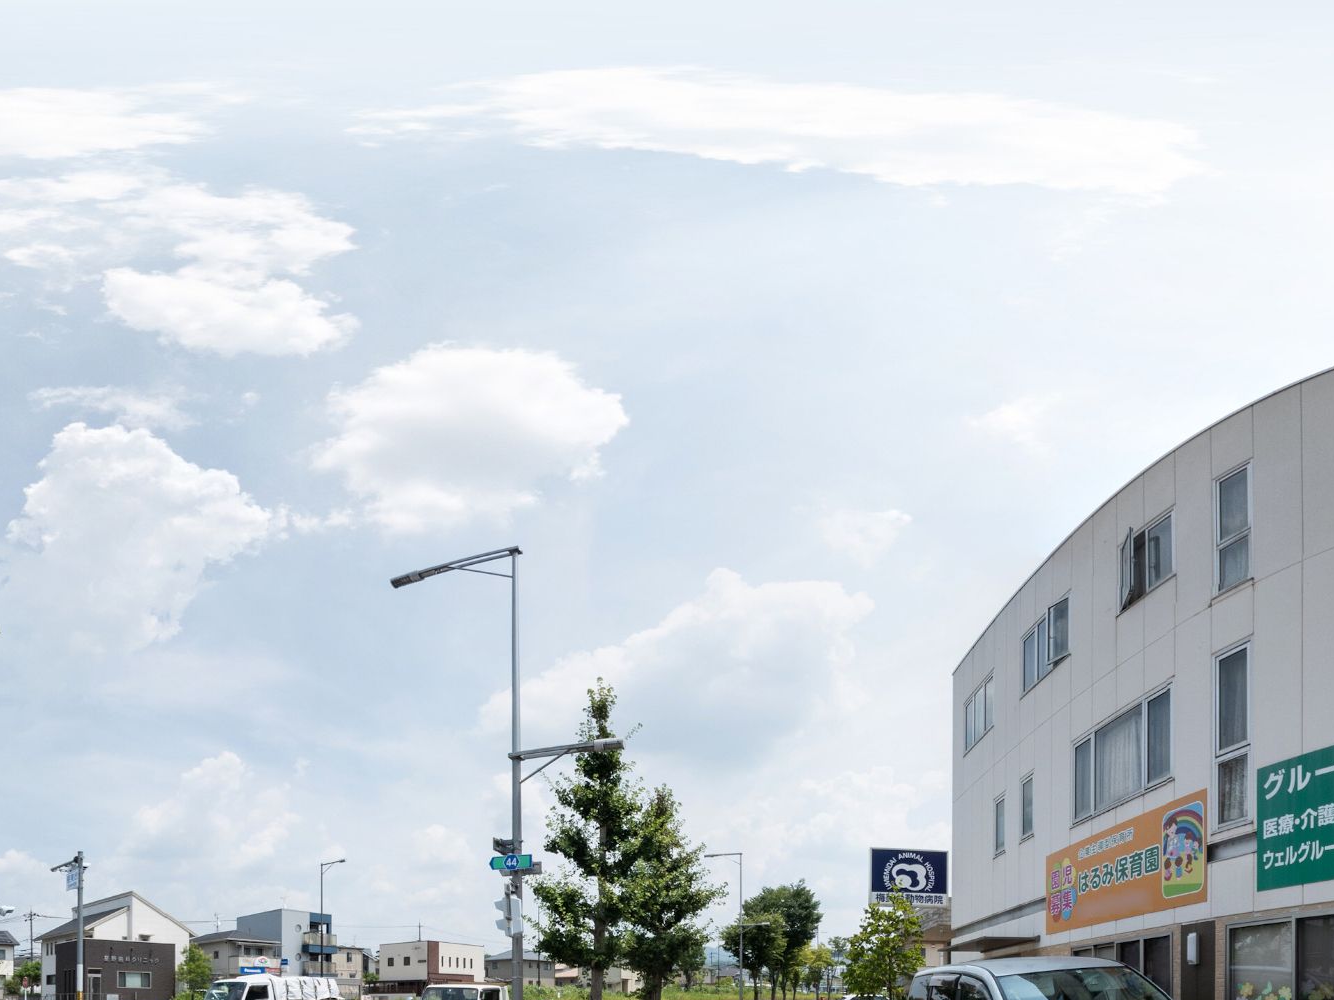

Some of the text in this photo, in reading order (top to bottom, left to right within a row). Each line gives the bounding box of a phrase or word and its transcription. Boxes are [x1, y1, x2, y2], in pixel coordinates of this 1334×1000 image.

[506, 857, 517, 867] 44
[898, 852, 924, 863] ANIMAL
[924, 862, 936, 892] HOSPITAL
[1078, 844, 1160, 894] はるみ保育園
